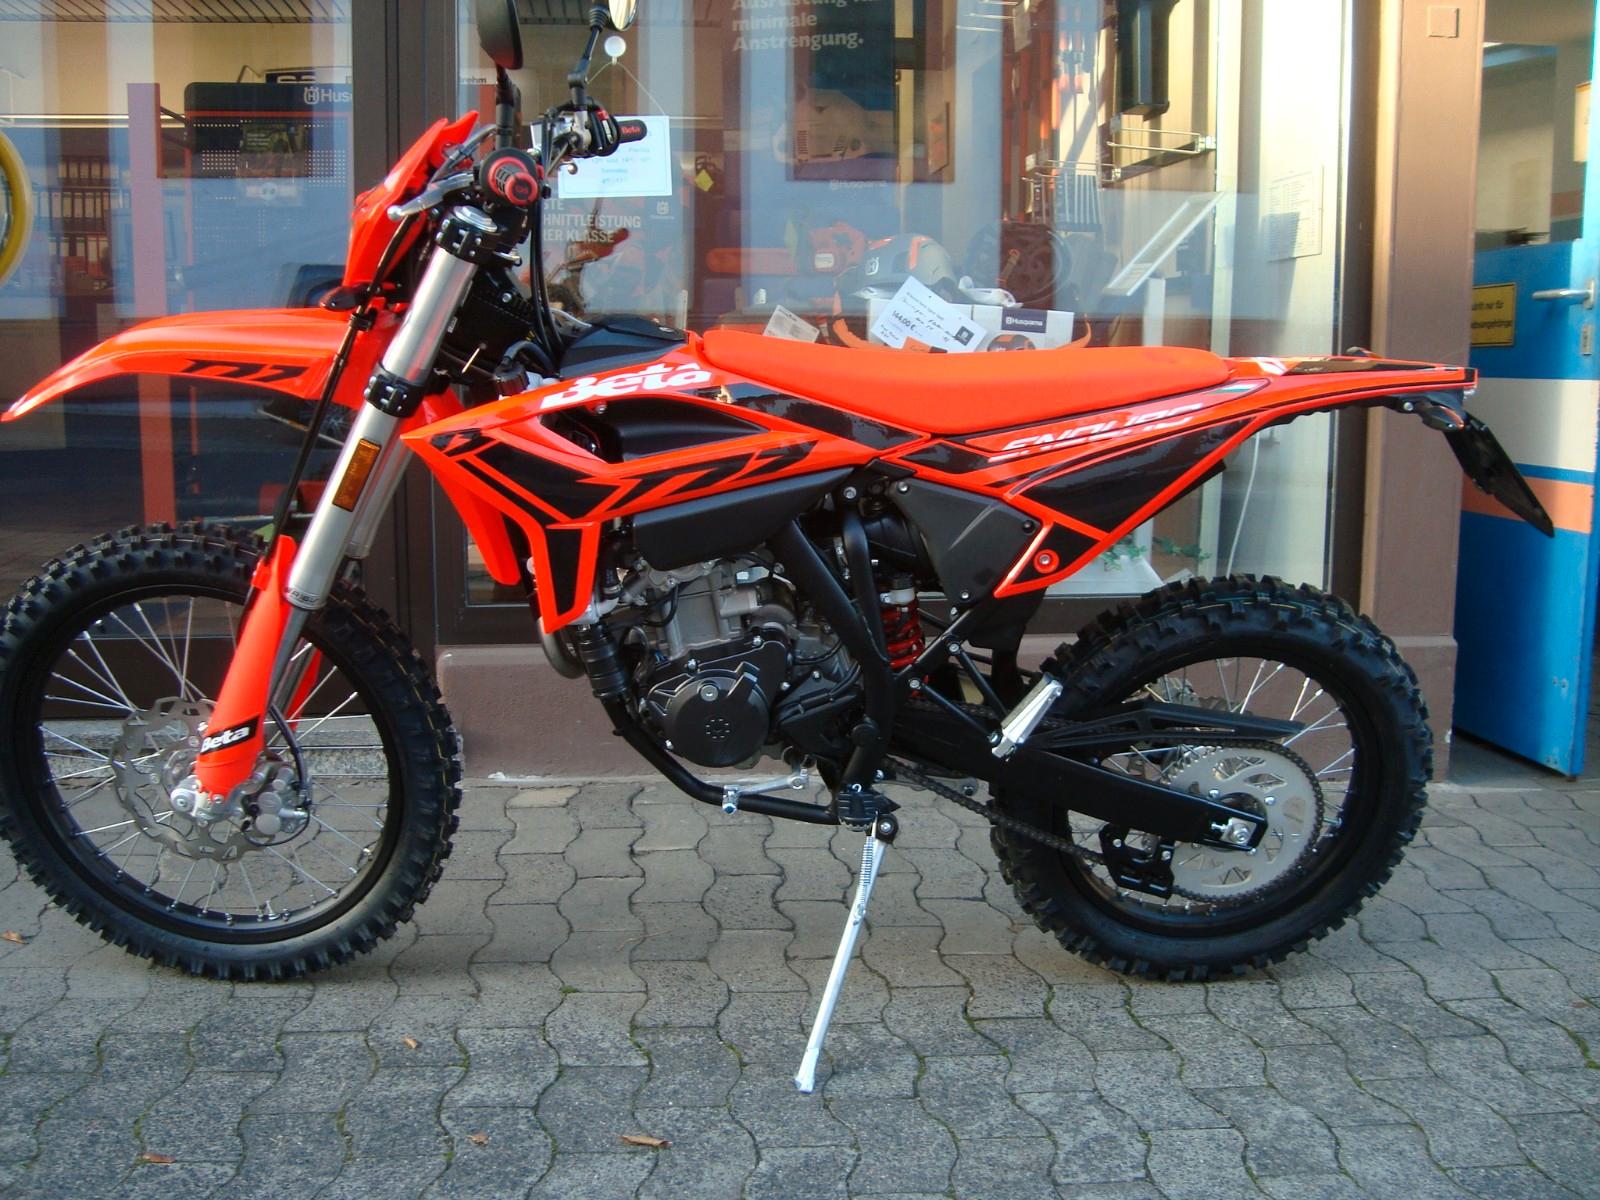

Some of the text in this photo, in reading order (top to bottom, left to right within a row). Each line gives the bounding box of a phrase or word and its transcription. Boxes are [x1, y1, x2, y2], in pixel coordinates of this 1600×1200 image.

[732, 12, 818, 31] minimale
[733, 32, 864, 51] Anstrengung.
[566, 230, 616, 243] KLASSE
[539, 363, 712, 409] Beta
[200, 726, 250, 753] Beta
